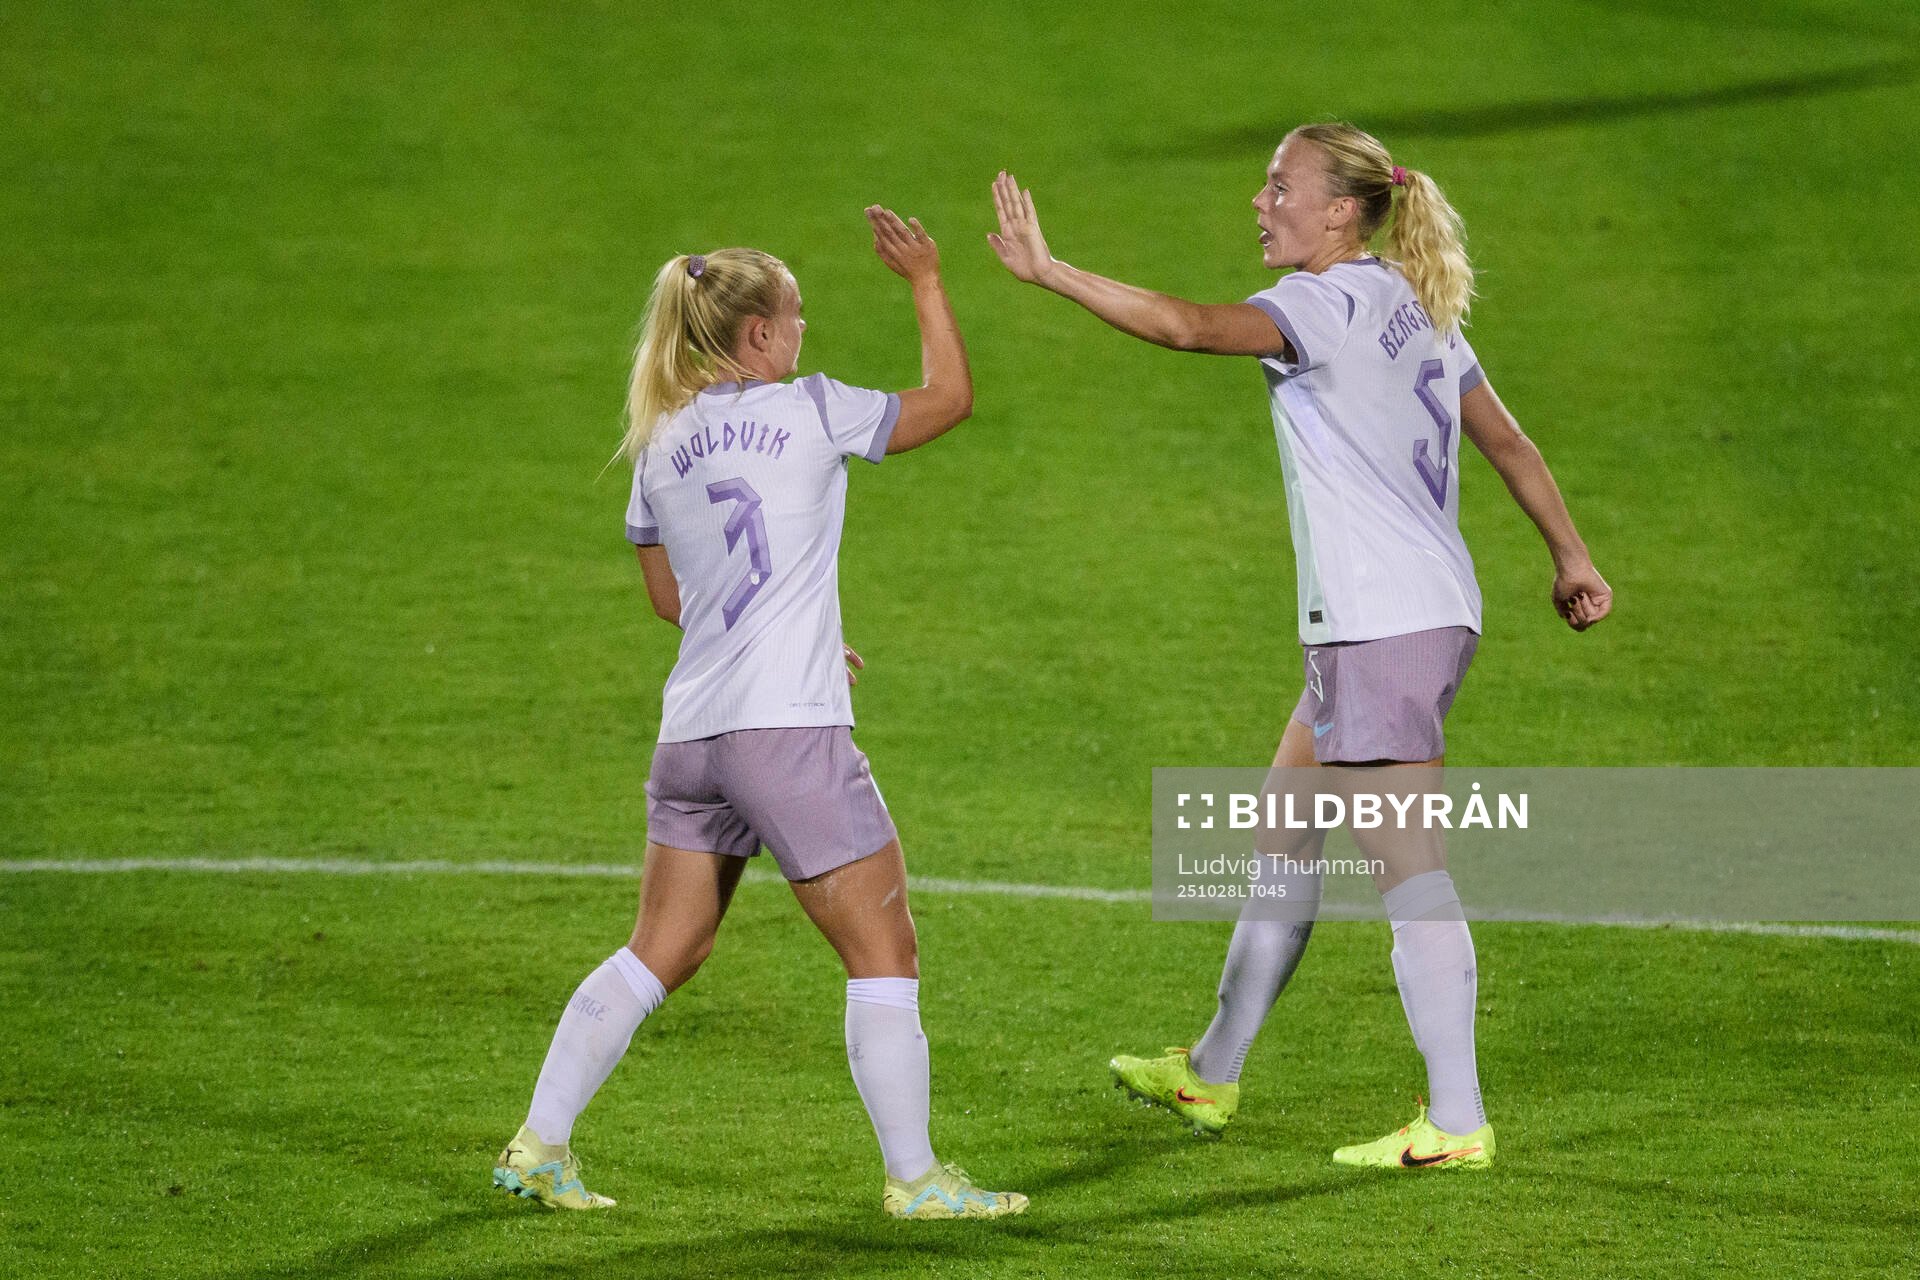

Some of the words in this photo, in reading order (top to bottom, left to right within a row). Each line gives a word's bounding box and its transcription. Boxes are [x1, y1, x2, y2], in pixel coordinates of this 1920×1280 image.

[1378, 300, 1456, 360] BERGS
[1413, 358, 1451, 512] 5
[705, 476, 772, 632] 3
[1308, 650, 1324, 703] 5
